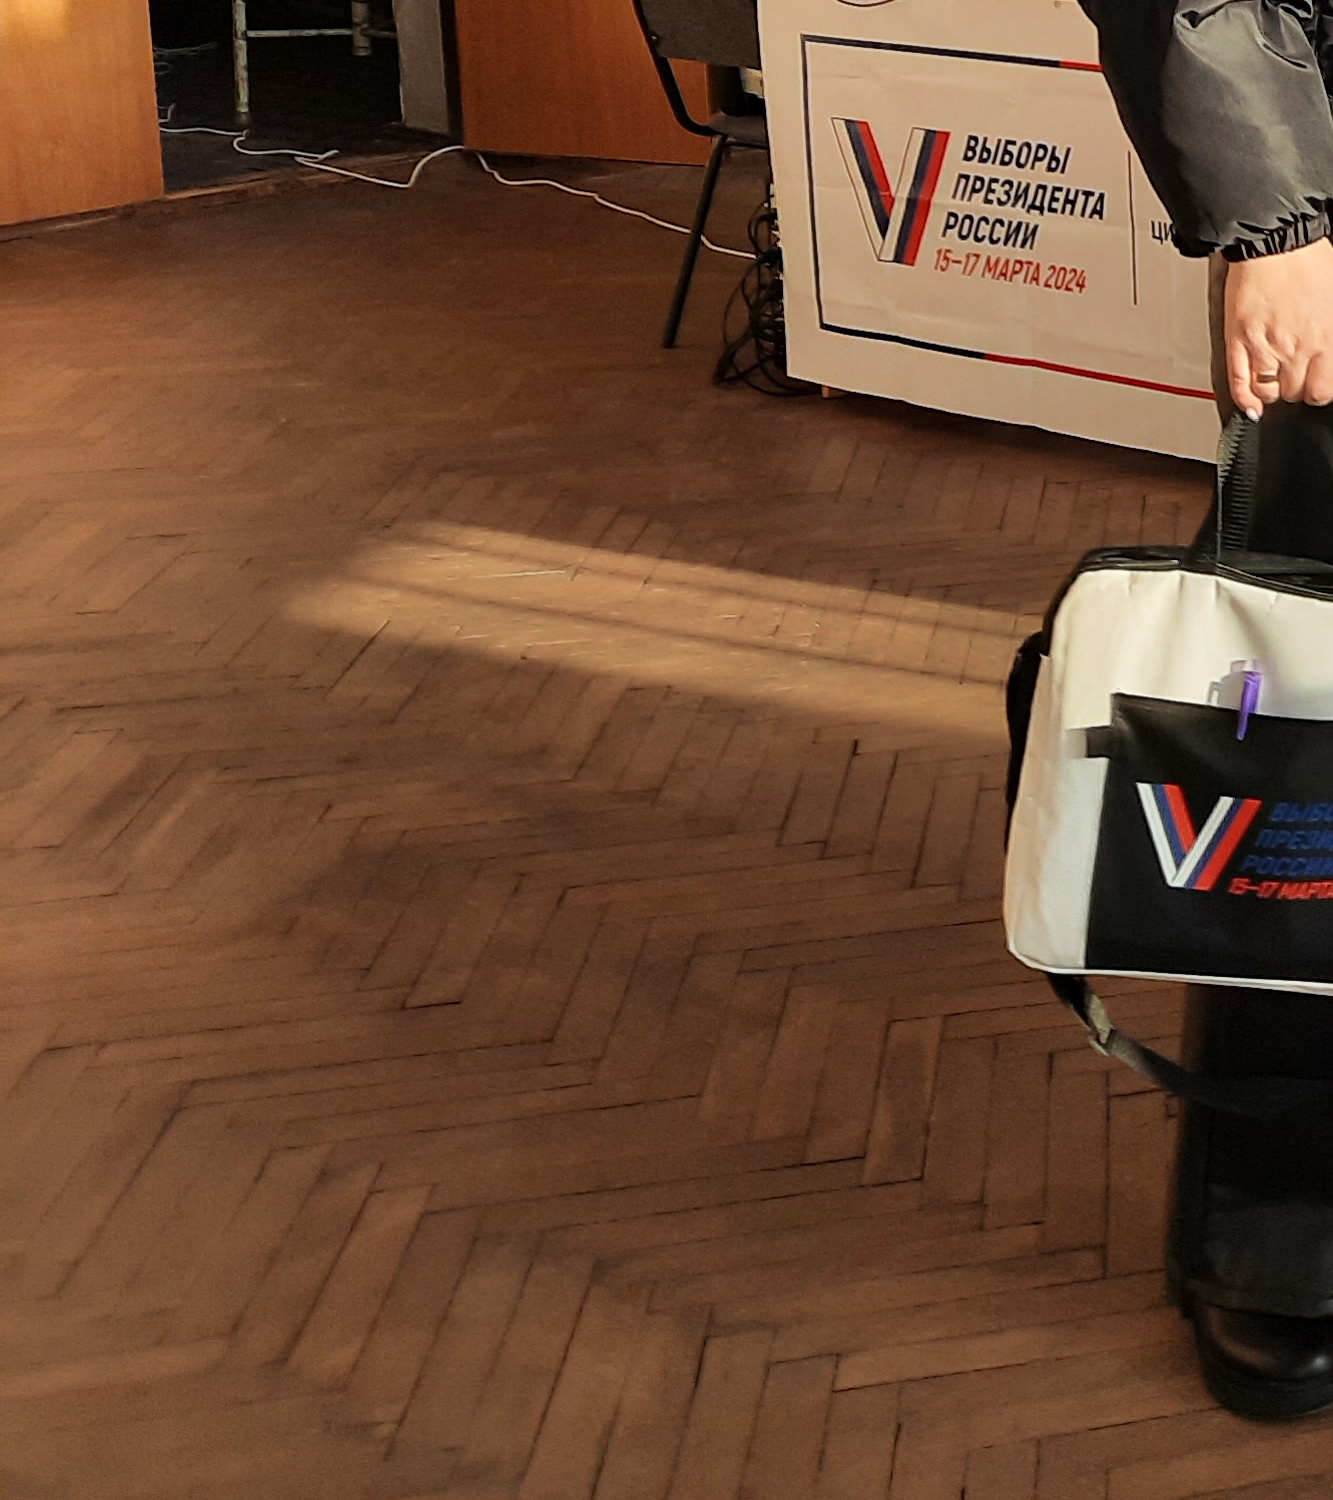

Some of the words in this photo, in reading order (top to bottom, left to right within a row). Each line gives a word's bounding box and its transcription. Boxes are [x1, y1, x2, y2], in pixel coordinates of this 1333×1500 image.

[961, 134, 1072, 174] ВЫБОРЫ
[951, 173, 1106, 220] ПРЕЗИДЕНТА
[941, 211, 1040, 250] РОССИИ
[981, 254, 1041, 286] МАРТА
[1043, 264, 1087, 294] 2024
